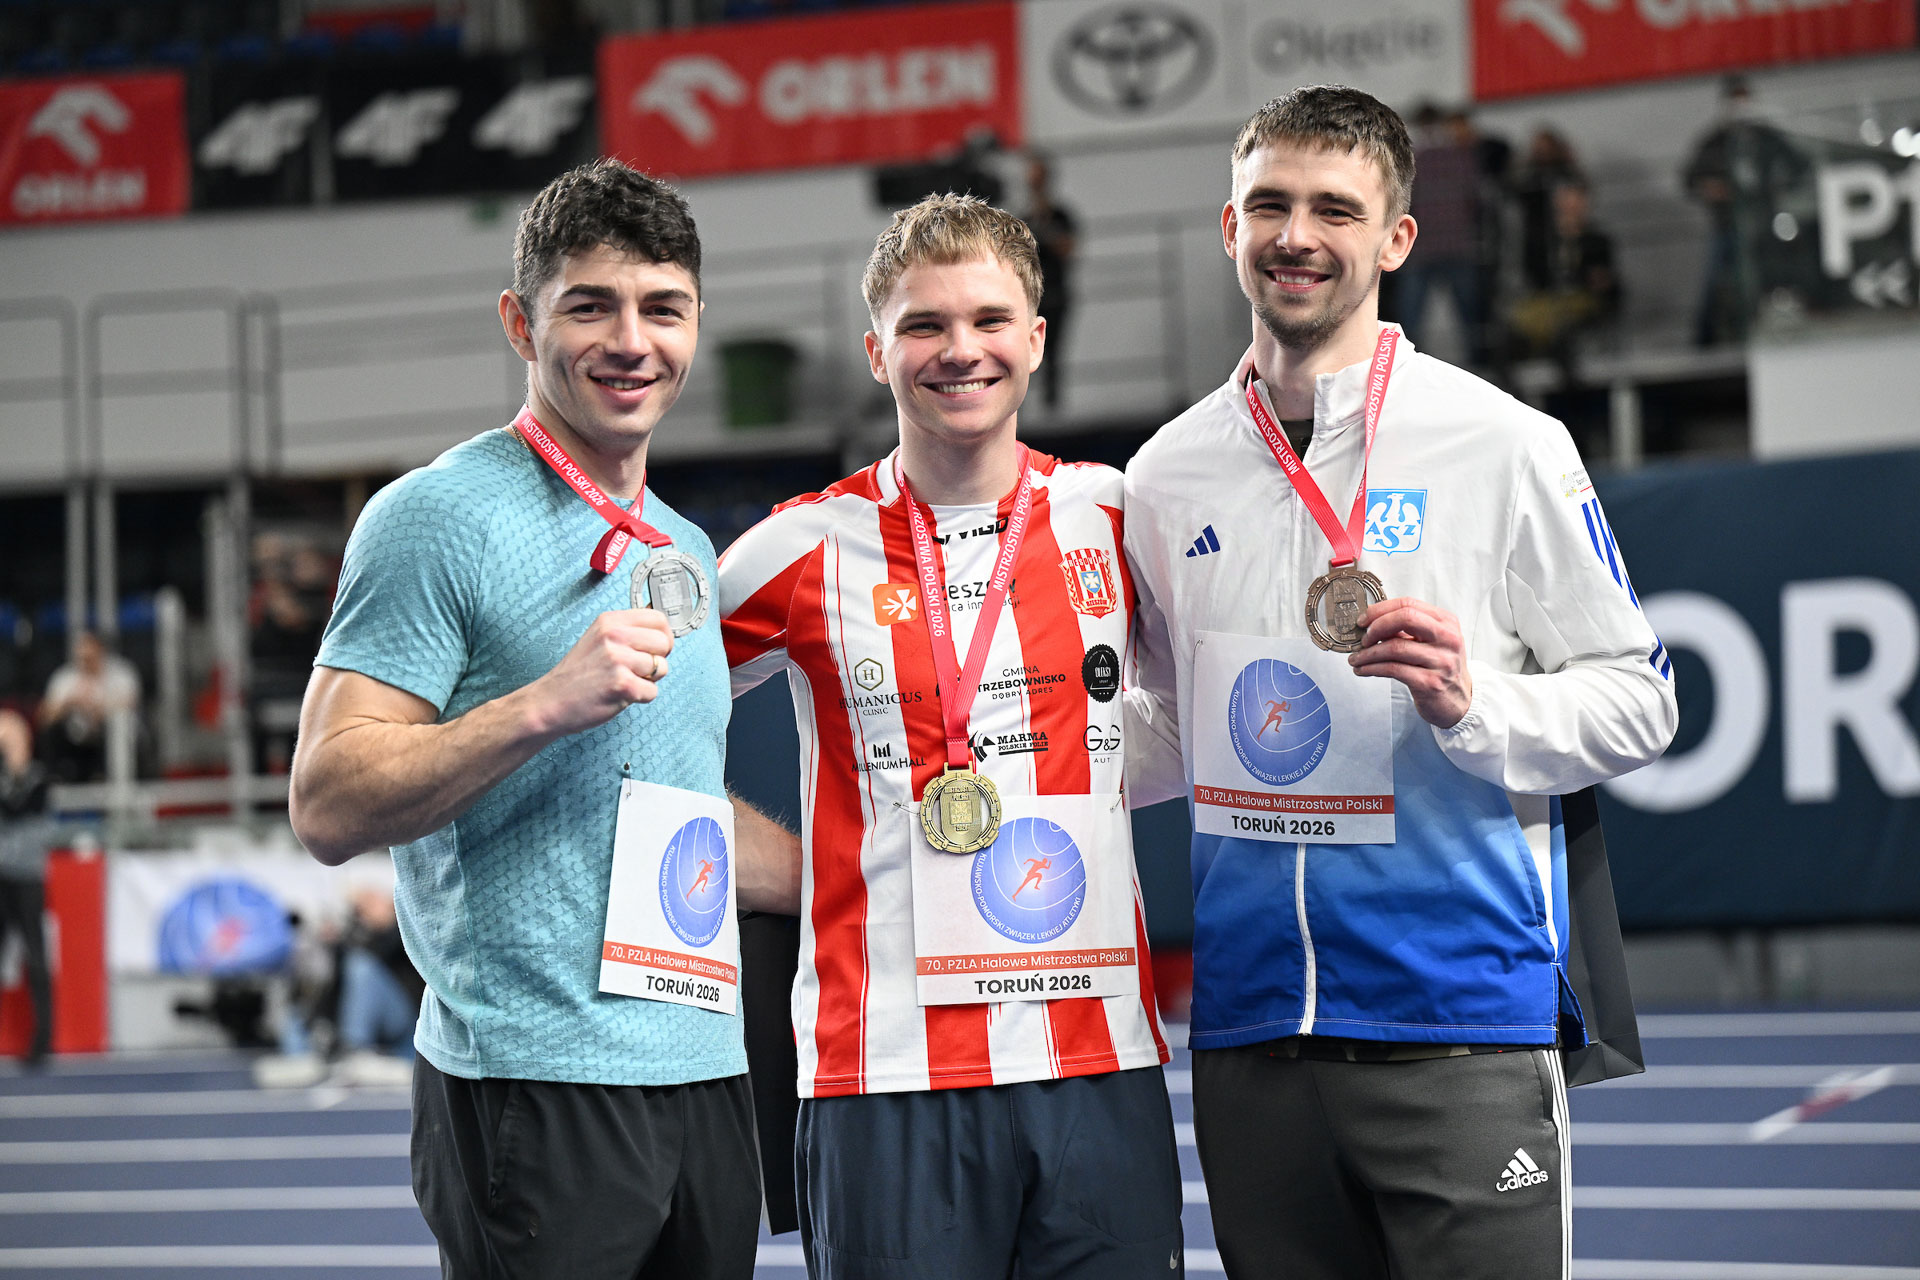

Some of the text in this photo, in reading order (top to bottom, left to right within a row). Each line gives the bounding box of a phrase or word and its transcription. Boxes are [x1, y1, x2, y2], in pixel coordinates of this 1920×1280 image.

[759, 44, 997, 125] ORLEN
[1366, 374, 1385, 448] MISTRZOSTWA
[1376, 336, 1393, 372] POLSKI
[1256, 407, 1300, 475] MISTRZOSTWA
[521, 416, 608, 507] MISTRZOSTWA POLSKI 2026
[993, 515, 1025, 592] MISTRZOSTWA
[923, 566, 940, 607] POLSKI
[931, 609, 946, 637] 2026
[977, 674, 1066, 692] TRZEBOWNISKO
[1002, 665, 1040, 678] GMINA
[839, 691, 923, 709] HUMANICUS
[992, 686, 1054, 700] DOBRY ADRES
[862, 707, 889, 716] CLINIC
[996, 731, 1048, 745] MARMA
[998, 742, 1027, 751] POLSKIE
[1251, 765, 1278, 782] ZWIĄZEK
[1277, 770, 1304, 783] LEKKIEJ
[1303, 741, 1324, 772] ATLETYKI
[1200, 788, 1383, 811] 70. PZLA Halowe Mistrzostwa Polski
[1231, 815, 1336, 836] TORUŃ 2026
[1003, 924, 1036, 941] ZWIĄZEK
[1036, 925, 1064, 941] LEKKIEJ
[1062, 896, 1082, 928] ATLETYKI
[610, 945, 737, 981] 70. PZLA Halowe Mistrzostwa Polski
[926, 949, 1128, 971] 70. PZLA Halowe Mistrzostwa Polski
[646, 975, 720, 1003] TORUŃ 2026
[974, 973, 1092, 995] TORUŃ 2026
[1495, 1170, 1549, 1192] adidas
